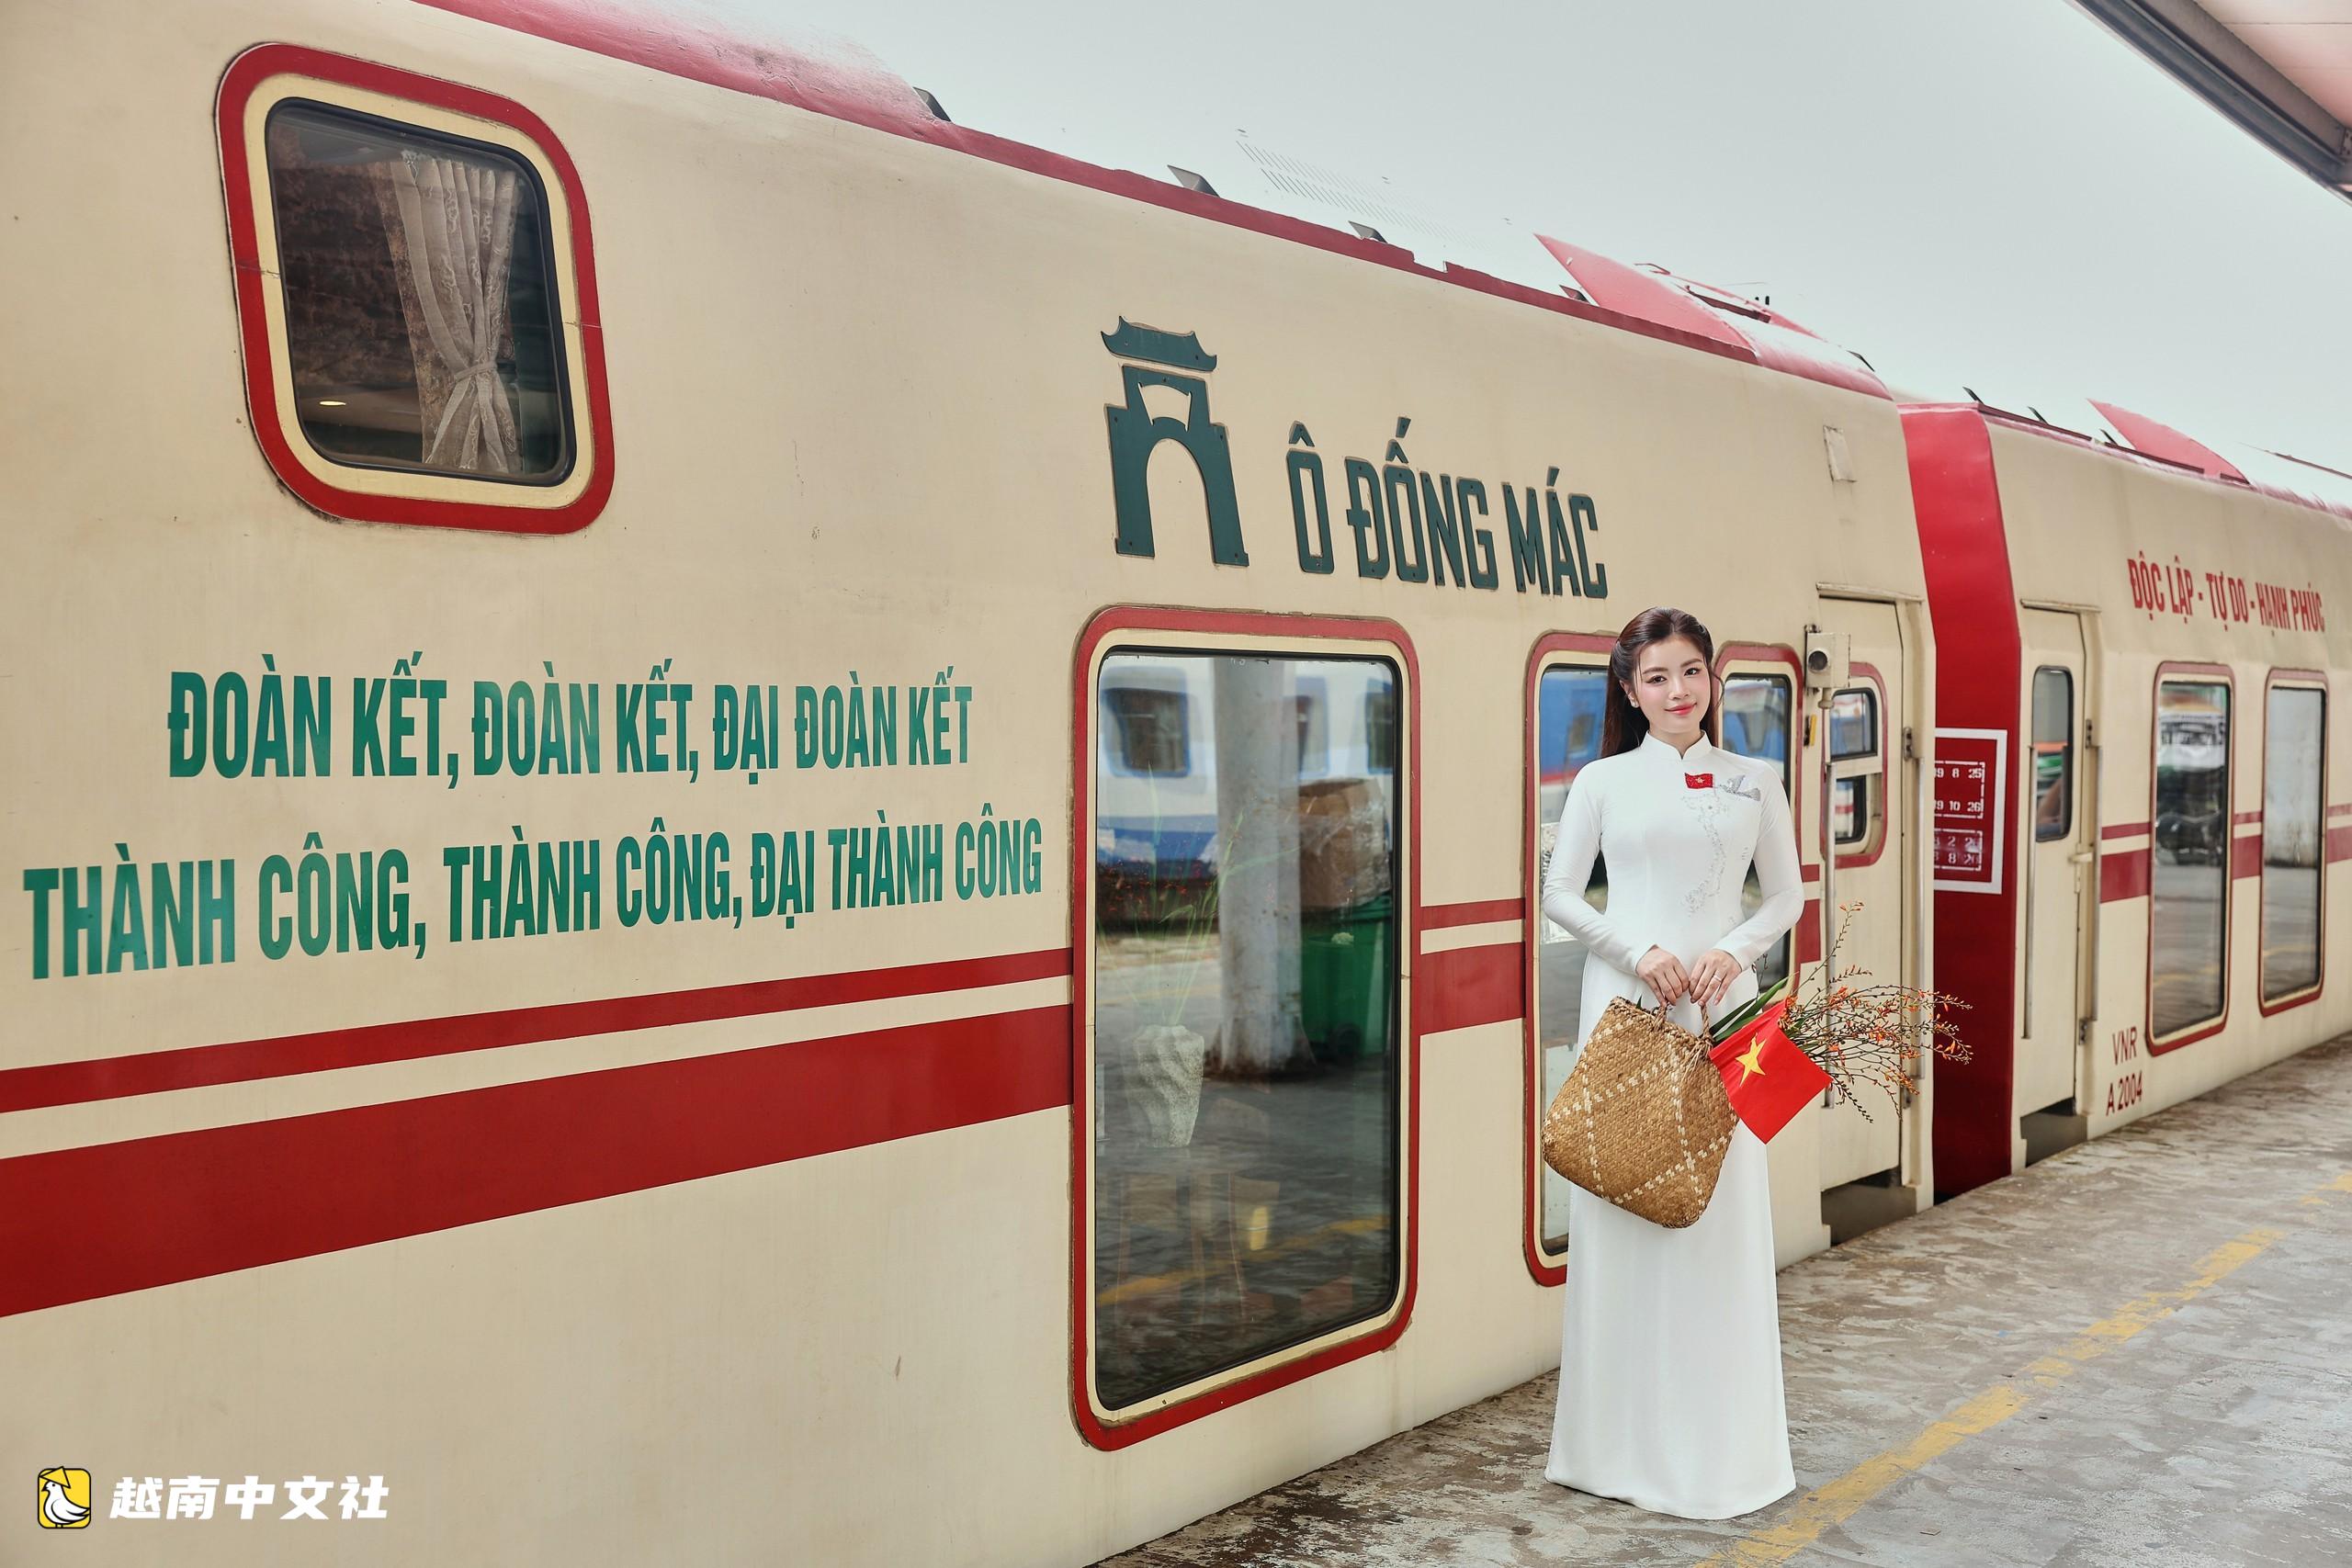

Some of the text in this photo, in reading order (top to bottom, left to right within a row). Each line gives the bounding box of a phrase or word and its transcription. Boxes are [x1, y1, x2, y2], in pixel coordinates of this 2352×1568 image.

[1286, 415, 1608, 599] Ô ĐỐNG MÁC
[2127, 550, 2165, 621] ĐỘC
[2228, 577, 2248, 624] DO
[167, 650, 972, 789] ĐOÀN KẾT, ĐOÀN KẾT, ĐẠI ĐOÀN KẾT
[1949, 800, 1961, 811] 10
[23, 802, 1042, 980] THÀNH CÔNG, THÀNH CÔNG, ĐẠI THÀNH CÔNG
[2112, 1026, 2137, 1066] VNR
[2106, 1070, 2143, 1116] A 2004
